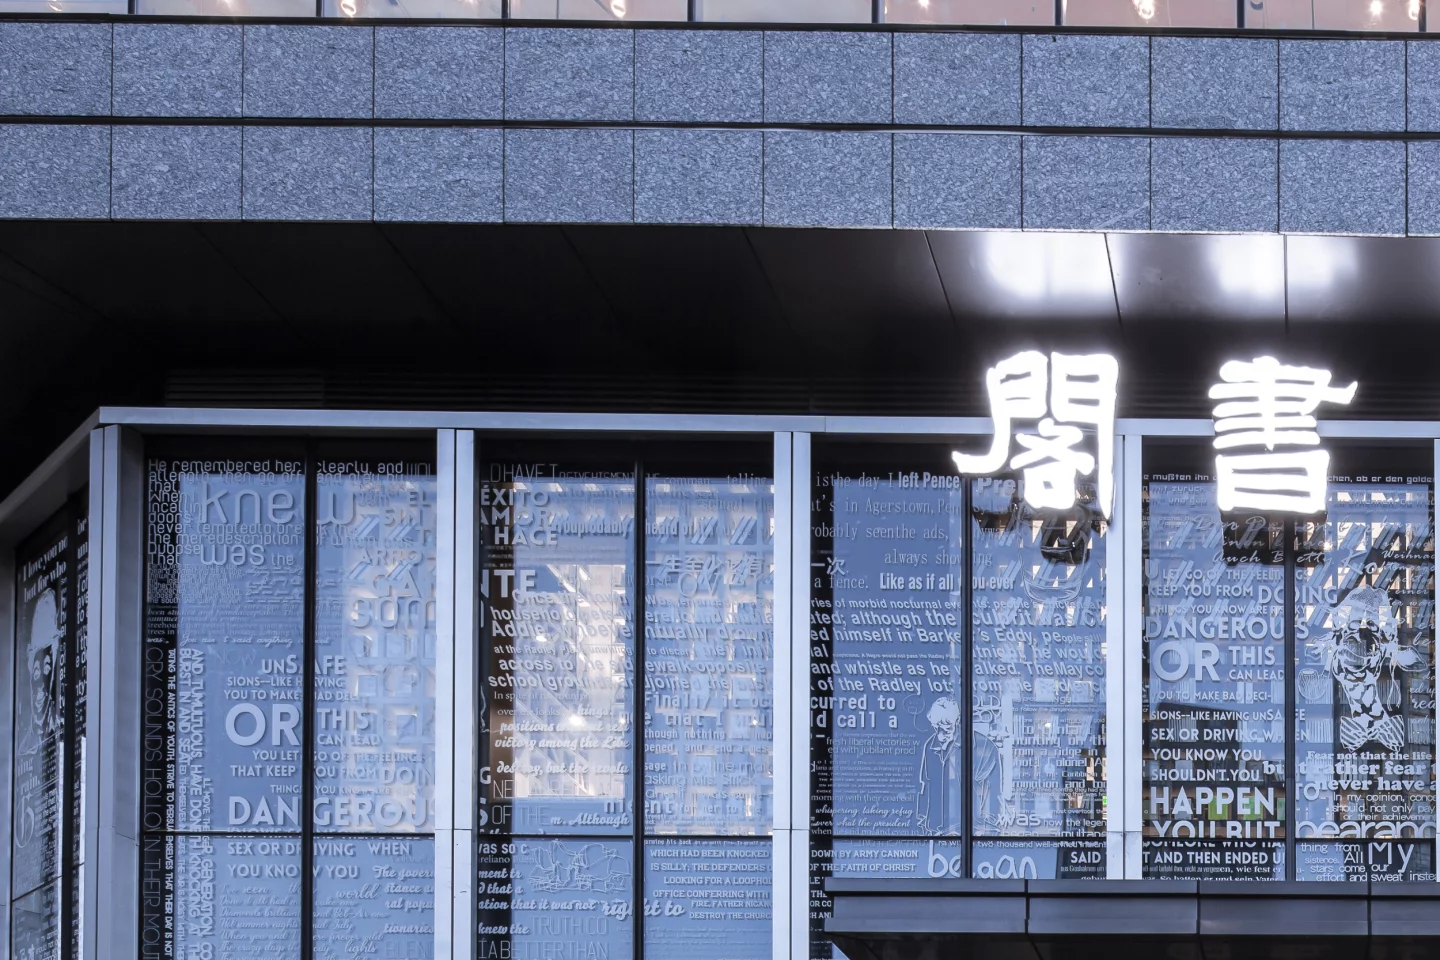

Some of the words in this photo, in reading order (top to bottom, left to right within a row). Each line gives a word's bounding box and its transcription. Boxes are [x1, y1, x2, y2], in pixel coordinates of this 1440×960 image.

[149, 459, 166, 472] He
[172, 459, 270, 472] remembered
[200, 543, 264, 565] was
[271, 554, 294, 565] the
[880, 574, 904, 590] Like
[852, 611, 922, 630] although
[927, 611, 956, 625] the
[834, 628, 891, 642] himself
[898, 630, 914, 642] in
[1152, 641, 1220, 681] OR
[1229, 646, 1275, 666] THIS
[845, 661, 902, 675] whistle
[908, 663, 925, 675] as
[930, 662, 949, 675] he
[839, 678, 864, 692] the
[869, 678, 921, 695] Radley
[224, 690, 248, 700] YOU
[270, 690, 299, 700] MAKE
[878, 695, 896, 709] to
[1213, 710, 1250, 720] HAVING
[226, 703, 301, 746] OR
[317, 708, 368, 729] THIS
[1152, 749, 1182, 761] YOU
[1186, 749, 1228, 761] KNOW
[1232, 749, 1261, 761] YOU
[1337, 752, 1357, 761] not
[1361, 752, 1387, 761] that
[1390, 752, 1409, 761] the
[230, 765, 263, 777] THAT
[267, 766, 295, 777] KEEP
[1385, 761, 1426, 775] fear
[1377, 778, 1425, 790] have
[1150, 786, 1274, 815] HAPPEN
[227, 843, 254, 855] SEX
[367, 843, 411, 855] WHEN
[651, 849, 680, 859] WHICH
[681, 849, 699, 859] HAD
[726, 849, 769, 859] KNOCKED
[854, 850, 879, 858] ARMY
[883, 850, 918, 858] CANNON
[1071, 851, 1101, 864] SAID
[1154, 851, 1183, 864] AND
[1187, 852, 1220, 864] THEN
[1225, 852, 1268, 864] ENDED
[1368, 843, 1414, 873] My
[711, 863, 765, 871] DEFENDERS
[840, 862, 867, 873] FAITH
[883, 862, 916, 873] CHRIST
[663, 877, 701, 885] LOOKING
[704, 877, 722, 885] FOR
[336, 884, 380, 900] world
[653, 890, 684, 898] OFFICE
[687, 890, 748, 898] CONFERRING
